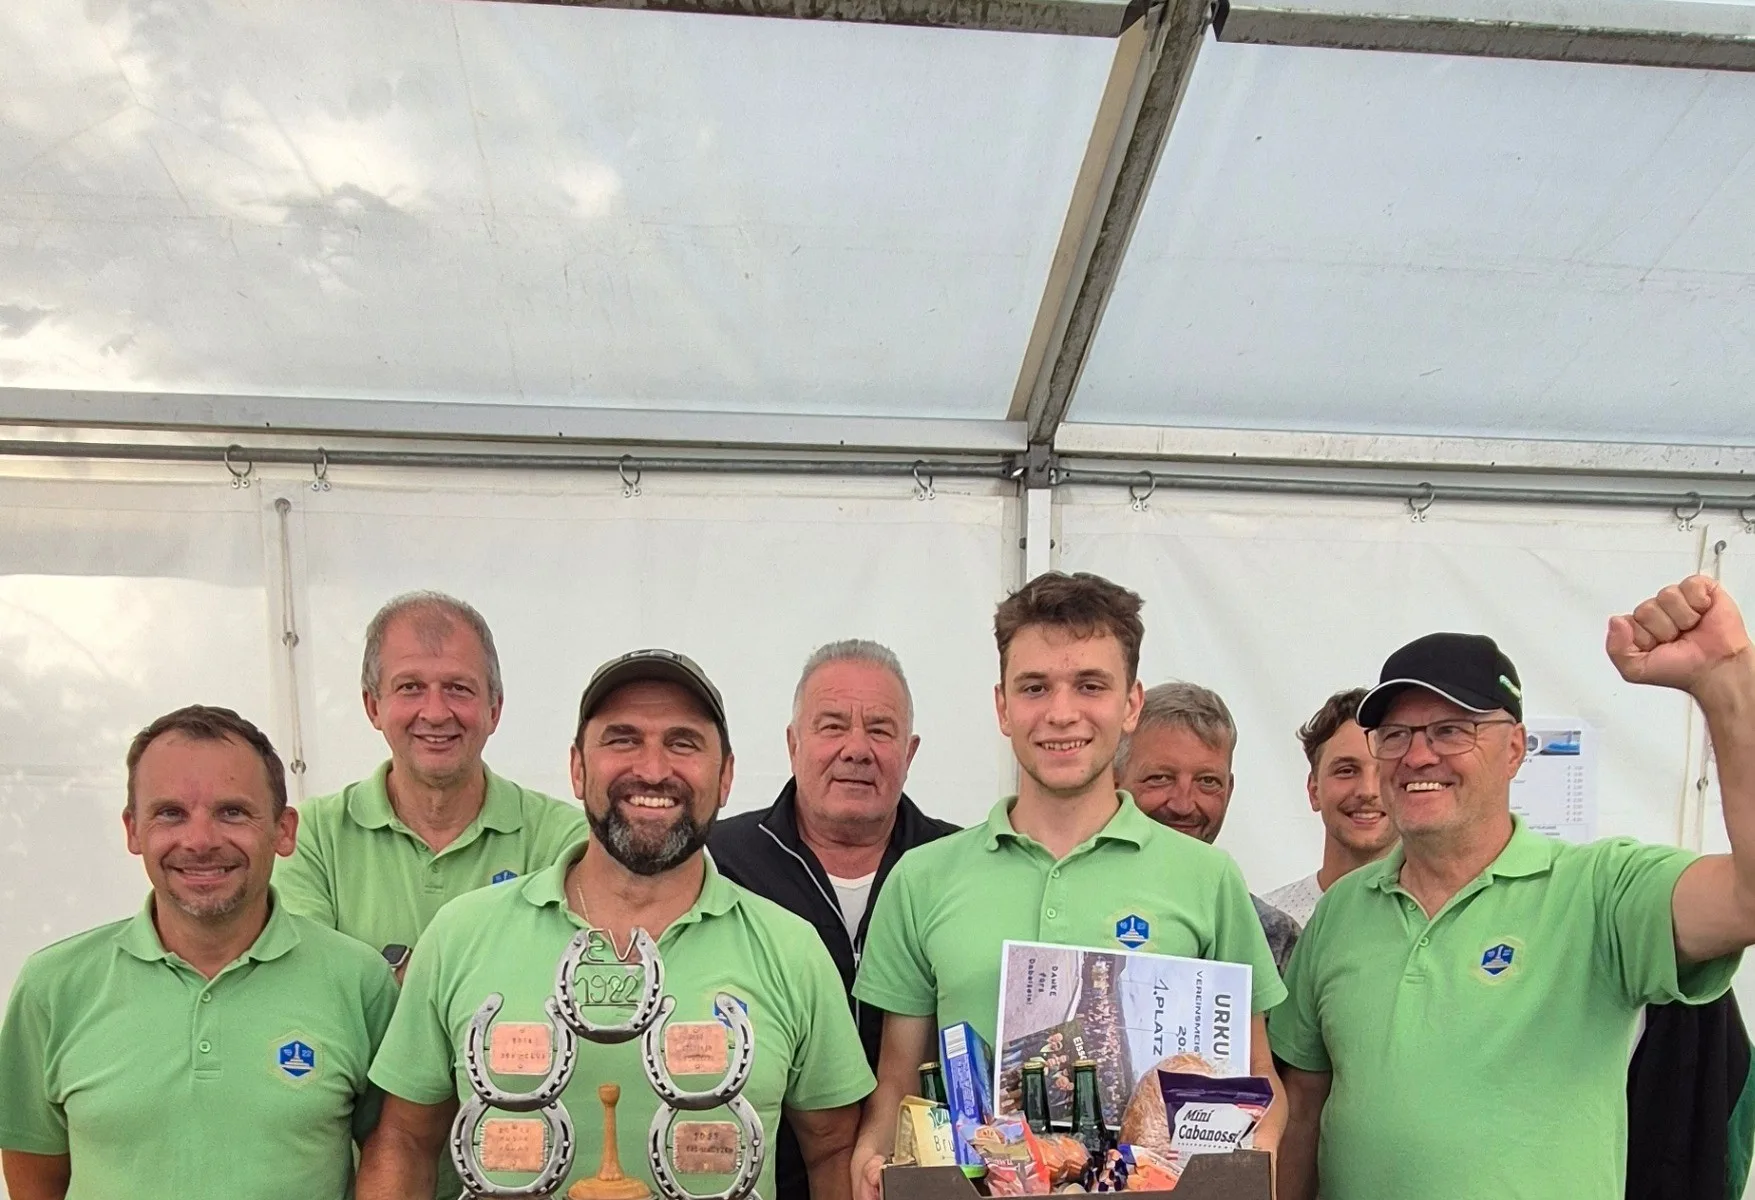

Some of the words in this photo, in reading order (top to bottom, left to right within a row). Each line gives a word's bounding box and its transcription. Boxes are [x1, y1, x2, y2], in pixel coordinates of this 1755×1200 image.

[587, 928, 638, 962] EV
[575, 975, 639, 1003] 1922
[1194, 970, 1203, 1054] VEREINSMEIS
[1213, 994, 1231, 1060] URKU
[1183, 1108, 1215, 1122] Mini
[933, 1134, 955, 1153] Bru
[1179, 1125, 1242, 1143] Cabanossi
